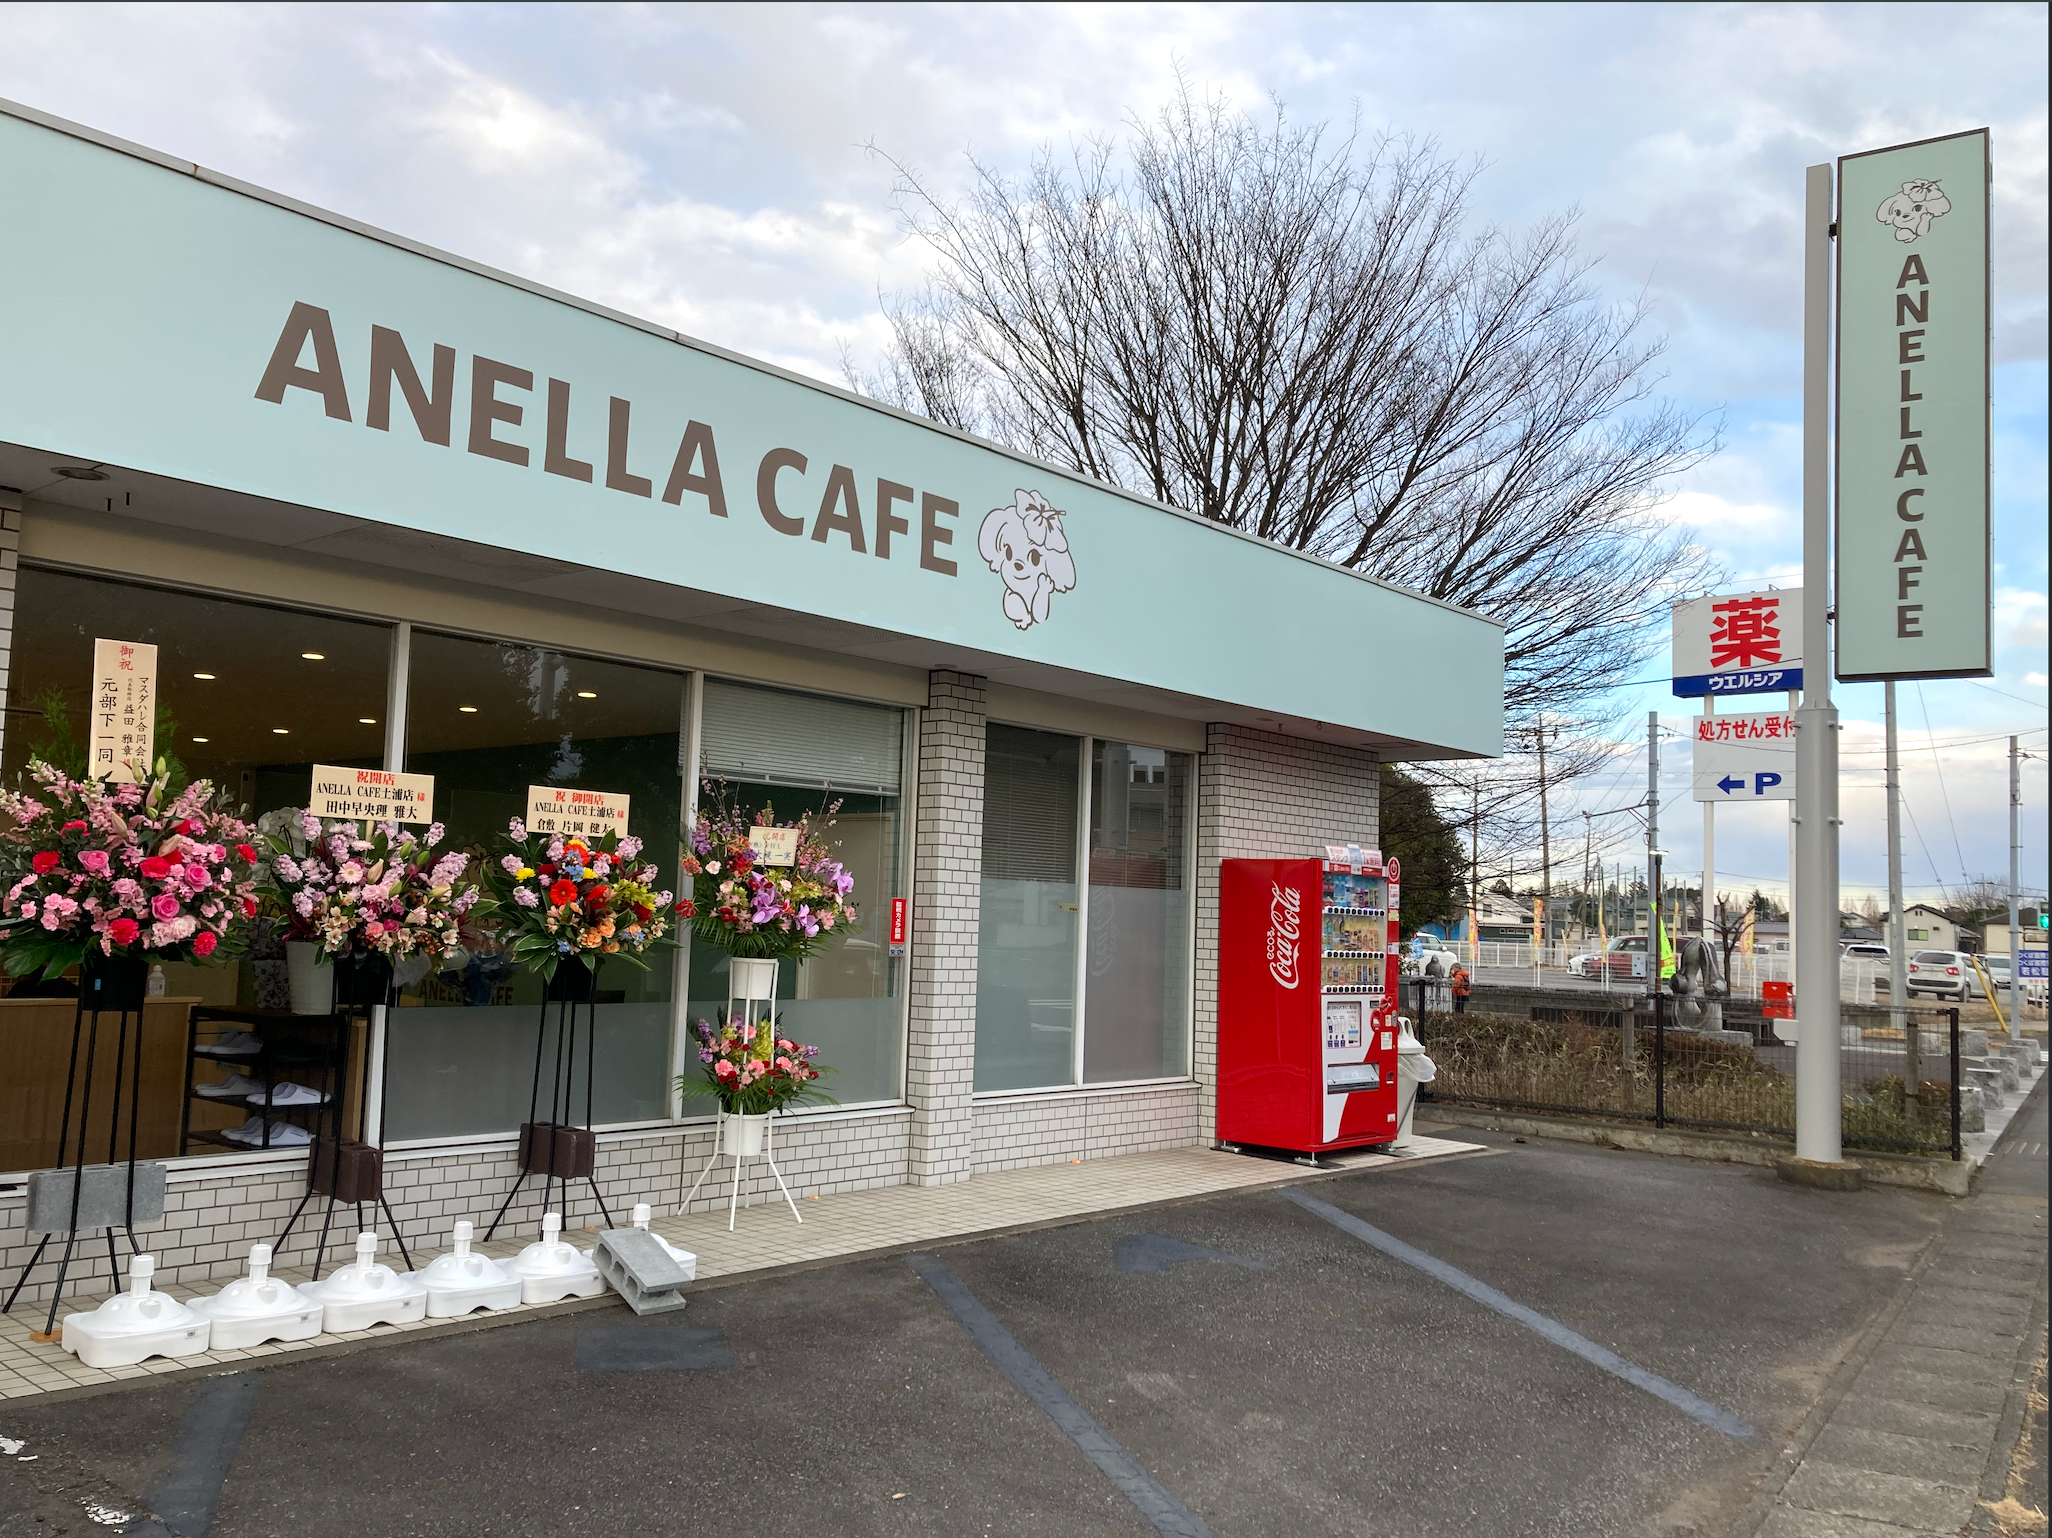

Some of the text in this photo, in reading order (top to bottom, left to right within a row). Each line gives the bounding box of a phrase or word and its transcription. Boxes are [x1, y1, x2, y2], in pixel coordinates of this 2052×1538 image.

[254, 300, 959, 577] ANELLA CAFE
[1894, 254, 1929, 639] ANELLA CAFE
[1709, 597, 1782, 668] 薬
[118, 645, 134, 671] 御祝
[1708, 671, 1783, 691] ウエルシア
[98, 678, 118, 763] 元部下一同
[316, 782, 351, 796] ANELLA
[356, 770, 395, 786] 祝開店
[1755, 773, 1782, 795] P
[534, 802, 563, 814] ANELLA
[1269, 880, 1300, 989] Coca-Cola
